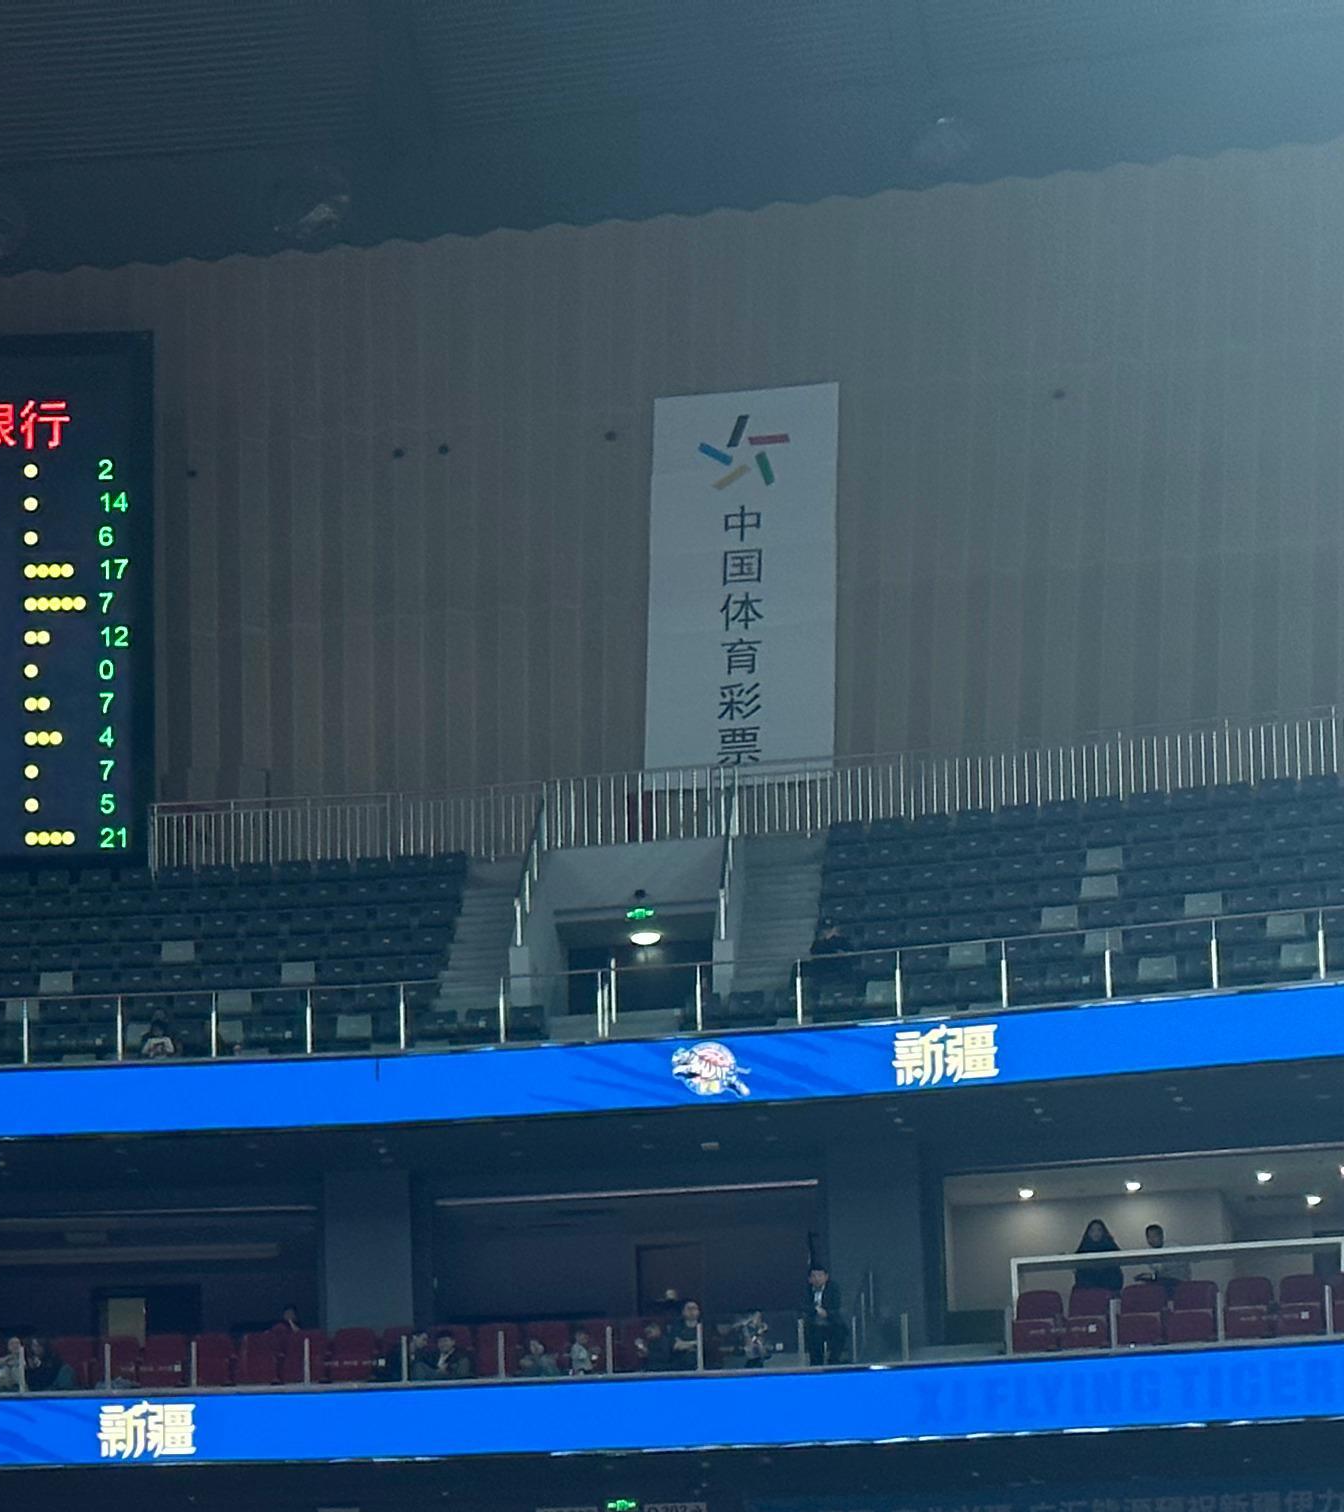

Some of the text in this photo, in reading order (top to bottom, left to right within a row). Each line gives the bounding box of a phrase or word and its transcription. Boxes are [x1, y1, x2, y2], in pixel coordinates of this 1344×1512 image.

[99, 459, 113, 480] 2
[100, 492, 128, 512] 14
[99, 526, 113, 546] 6
[101, 559, 128, 580] 17
[99, 592, 113, 613] 7
[101, 626, 129, 647] 12
[716, 504, 763, 766] 中国体育彩票
[99, 659, 113, 680] 0
[100, 692, 114, 713] 7
[99, 726, 114, 747] 4
[100, 760, 114, 781] 7
[101, 794, 115, 814] 5
[100, 827, 127, 848] 21
[892, 1023, 999, 1086] 新疆
[1176, 1357, 1344, 1410] TIGER
[97, 1400, 196, 1459] 新疆
